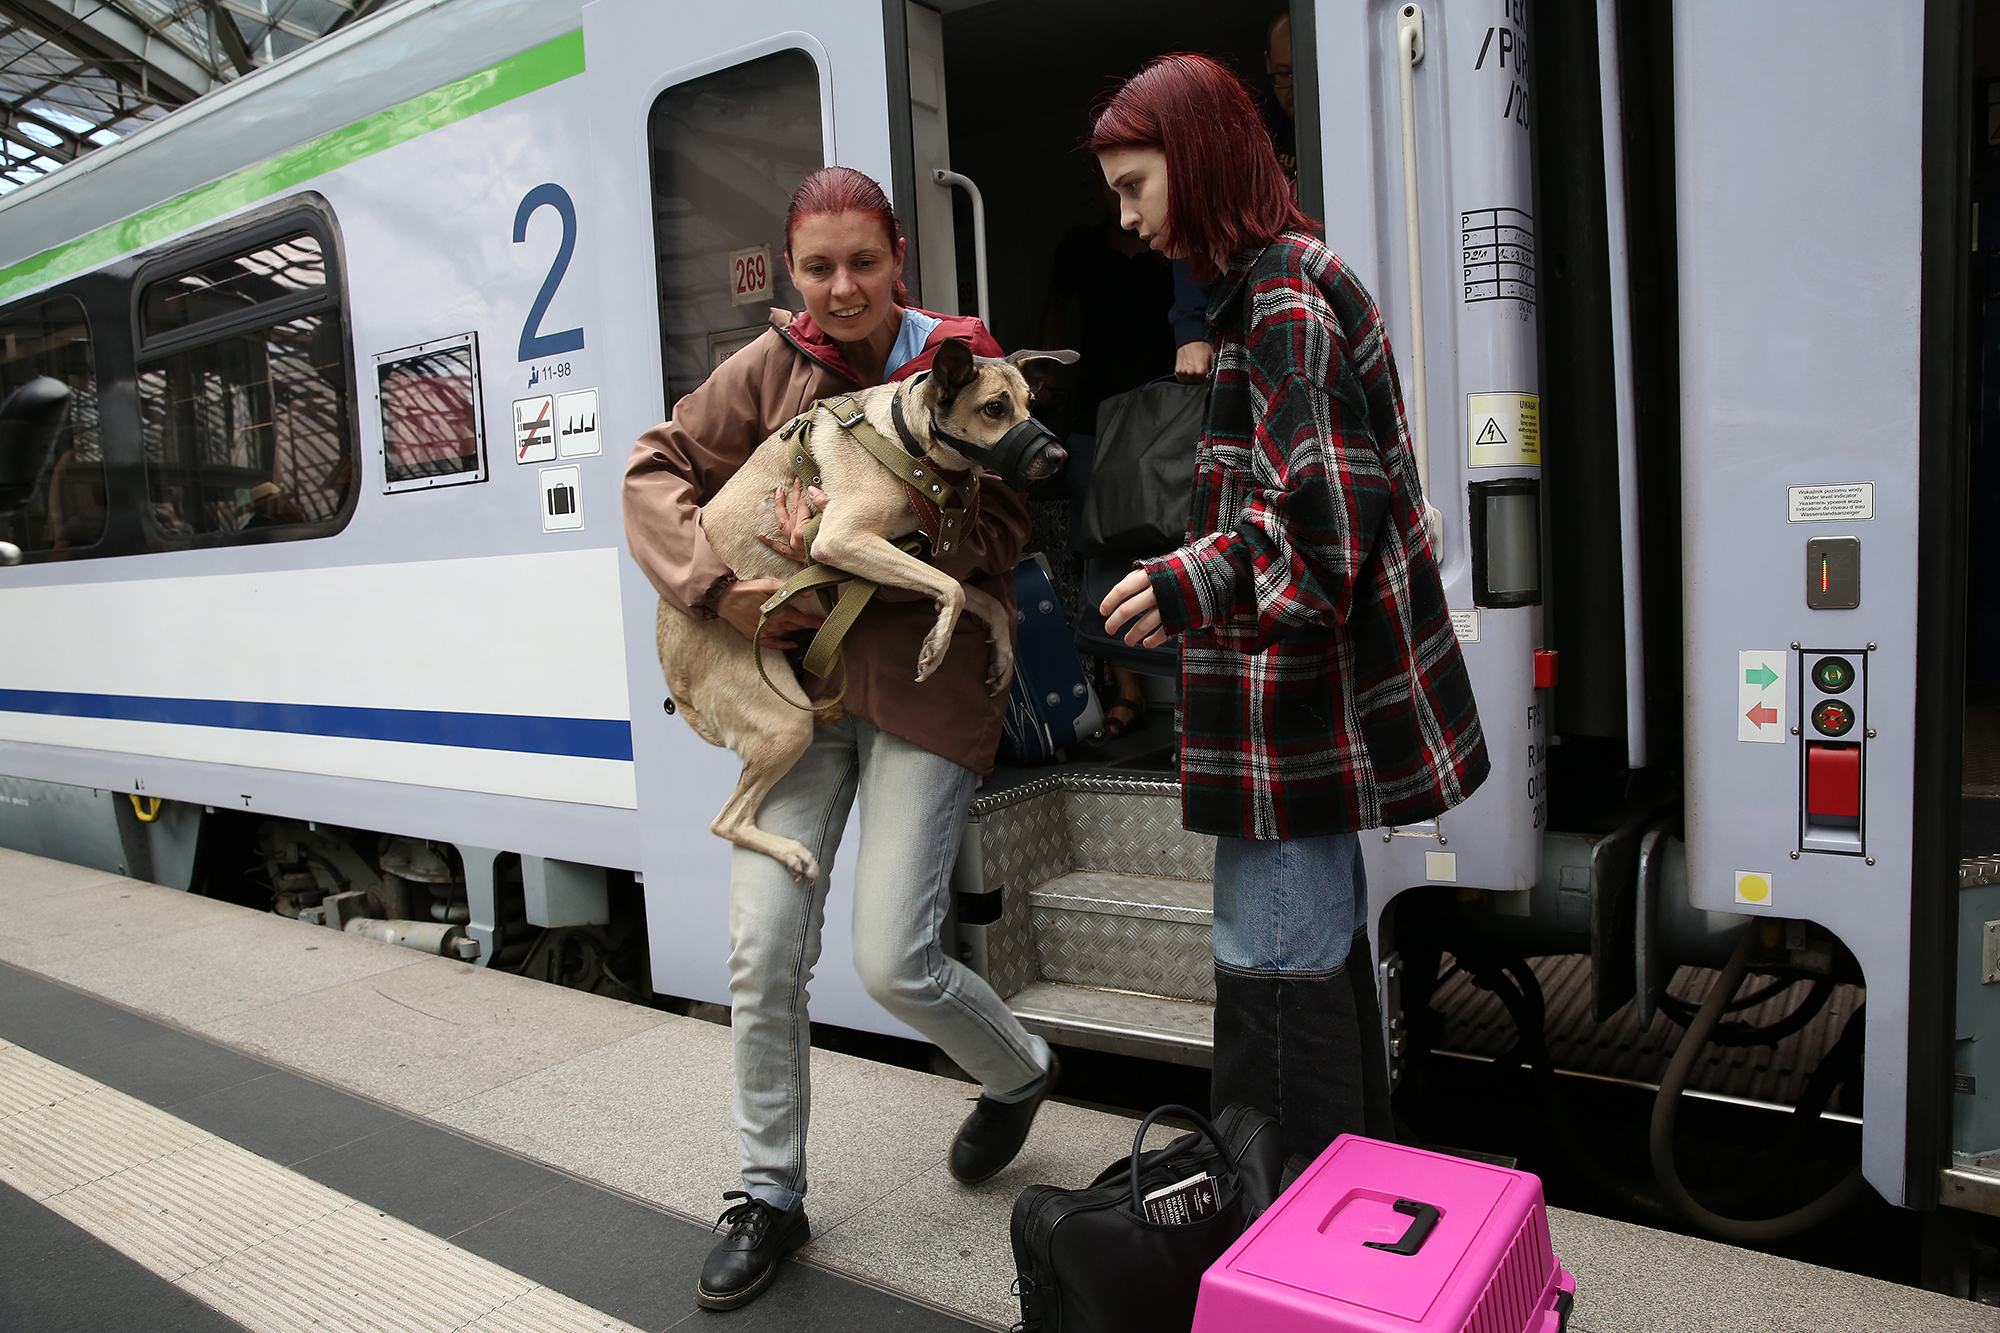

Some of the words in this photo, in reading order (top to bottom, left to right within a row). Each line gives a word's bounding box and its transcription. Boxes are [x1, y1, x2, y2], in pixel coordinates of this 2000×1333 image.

[1462, 216, 1470, 229] P
[1462, 234, 1470, 247] P
[512, 183, 585, 362] 2
[736, 255, 766, 294] 269
[1464, 269, 1472, 282] P
[1465, 286, 1472, 299] P
[542, 362, 571, 381] 11-98
[1165, 1198, 1176, 1225] KORON
[1175, 1194, 1185, 1217] NOWY
